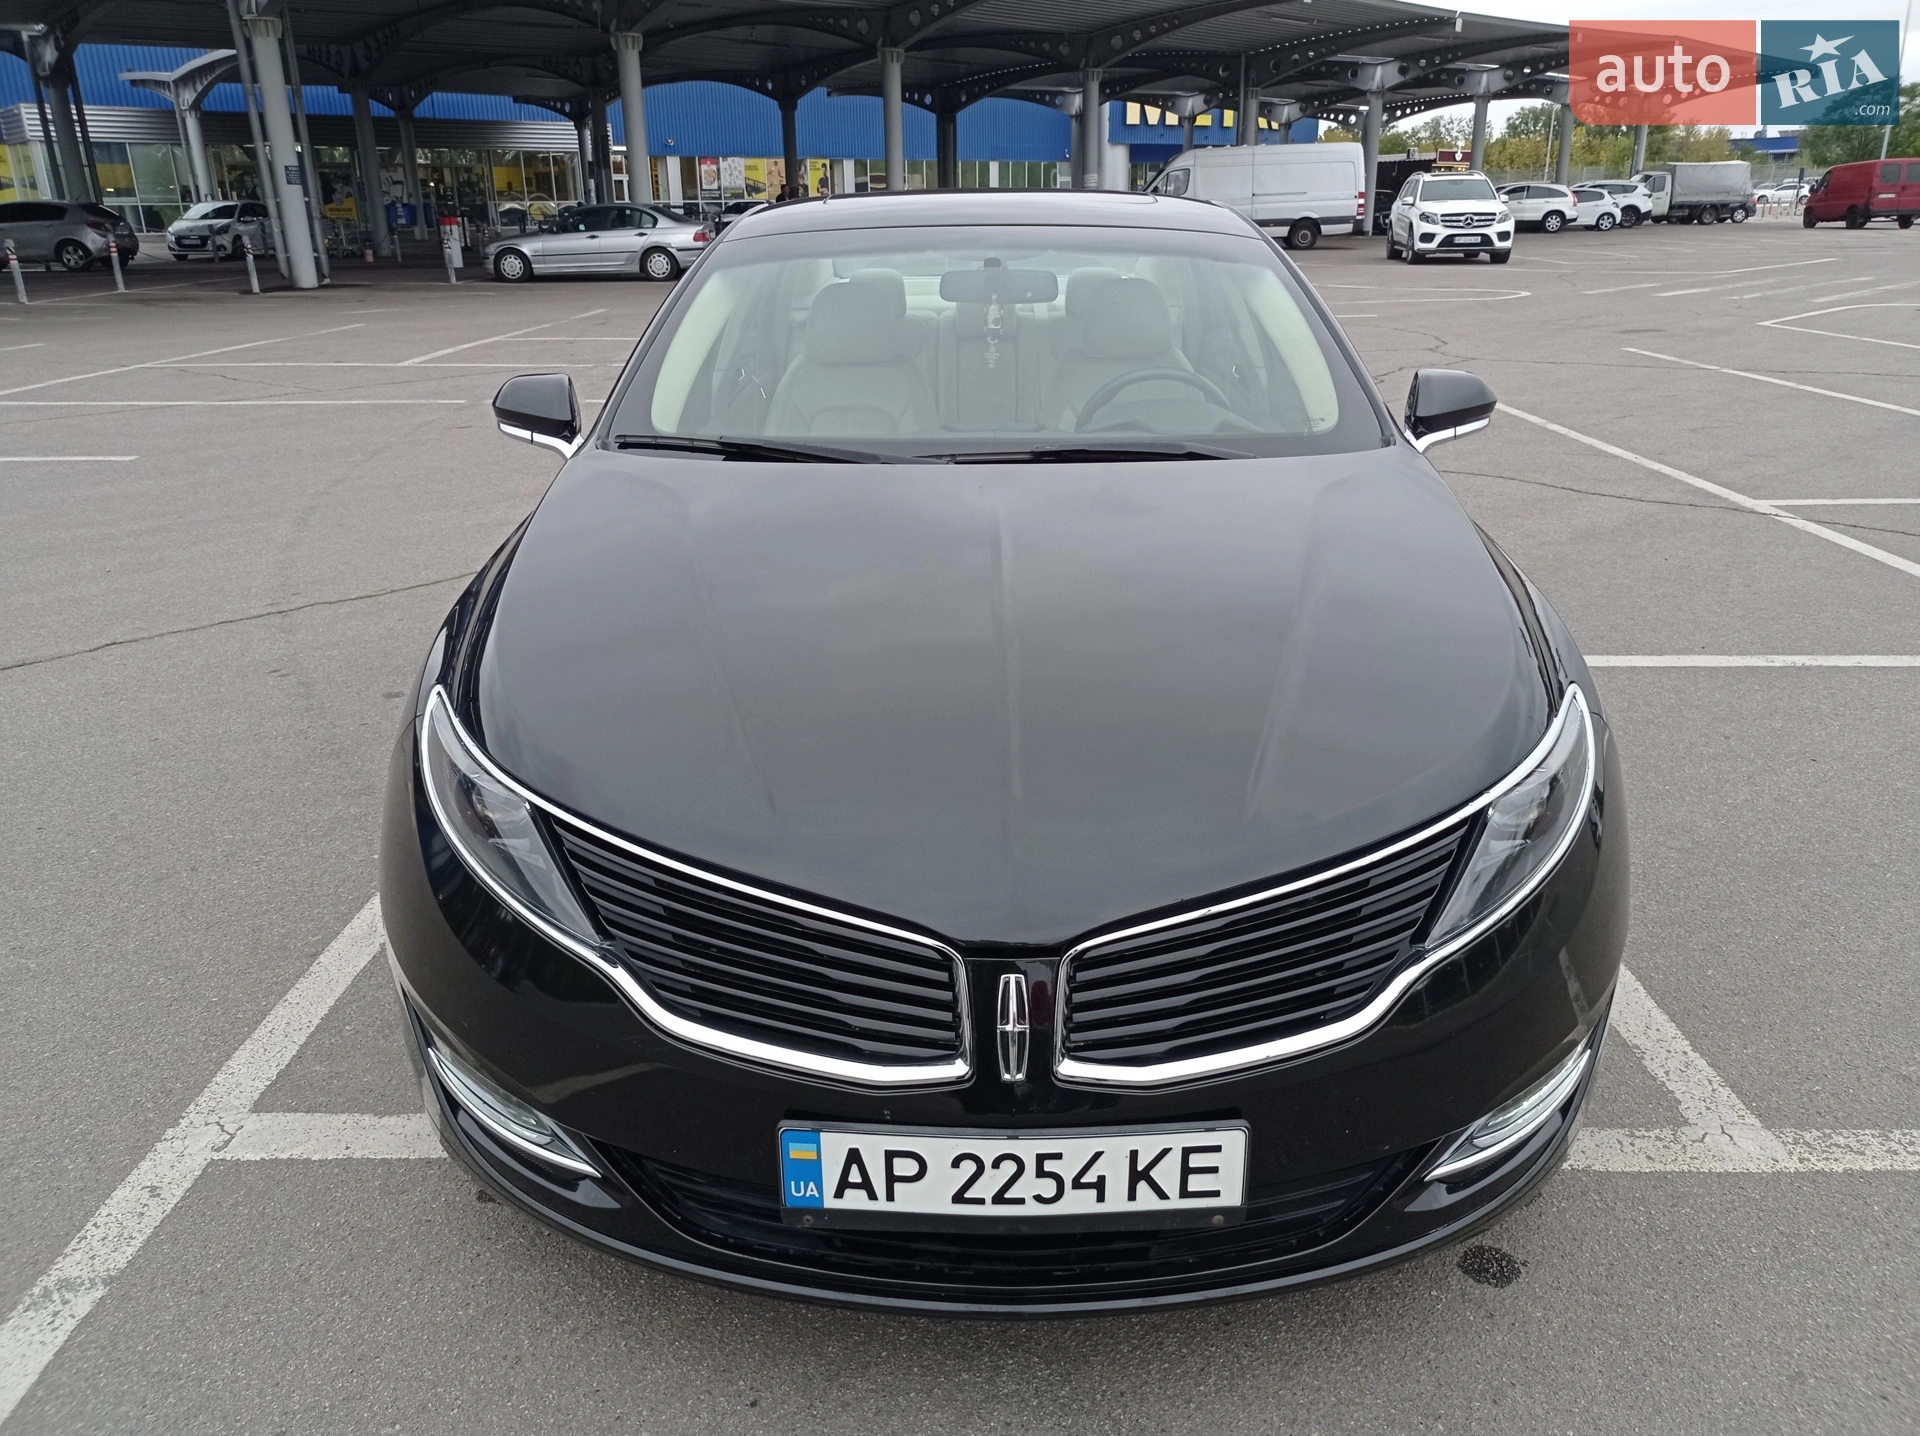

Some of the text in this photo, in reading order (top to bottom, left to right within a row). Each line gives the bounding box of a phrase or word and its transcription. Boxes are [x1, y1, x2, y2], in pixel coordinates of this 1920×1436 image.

[790, 1180, 820, 1198] UA
[832, 1144, 1223, 1205] AP 2254 KE
